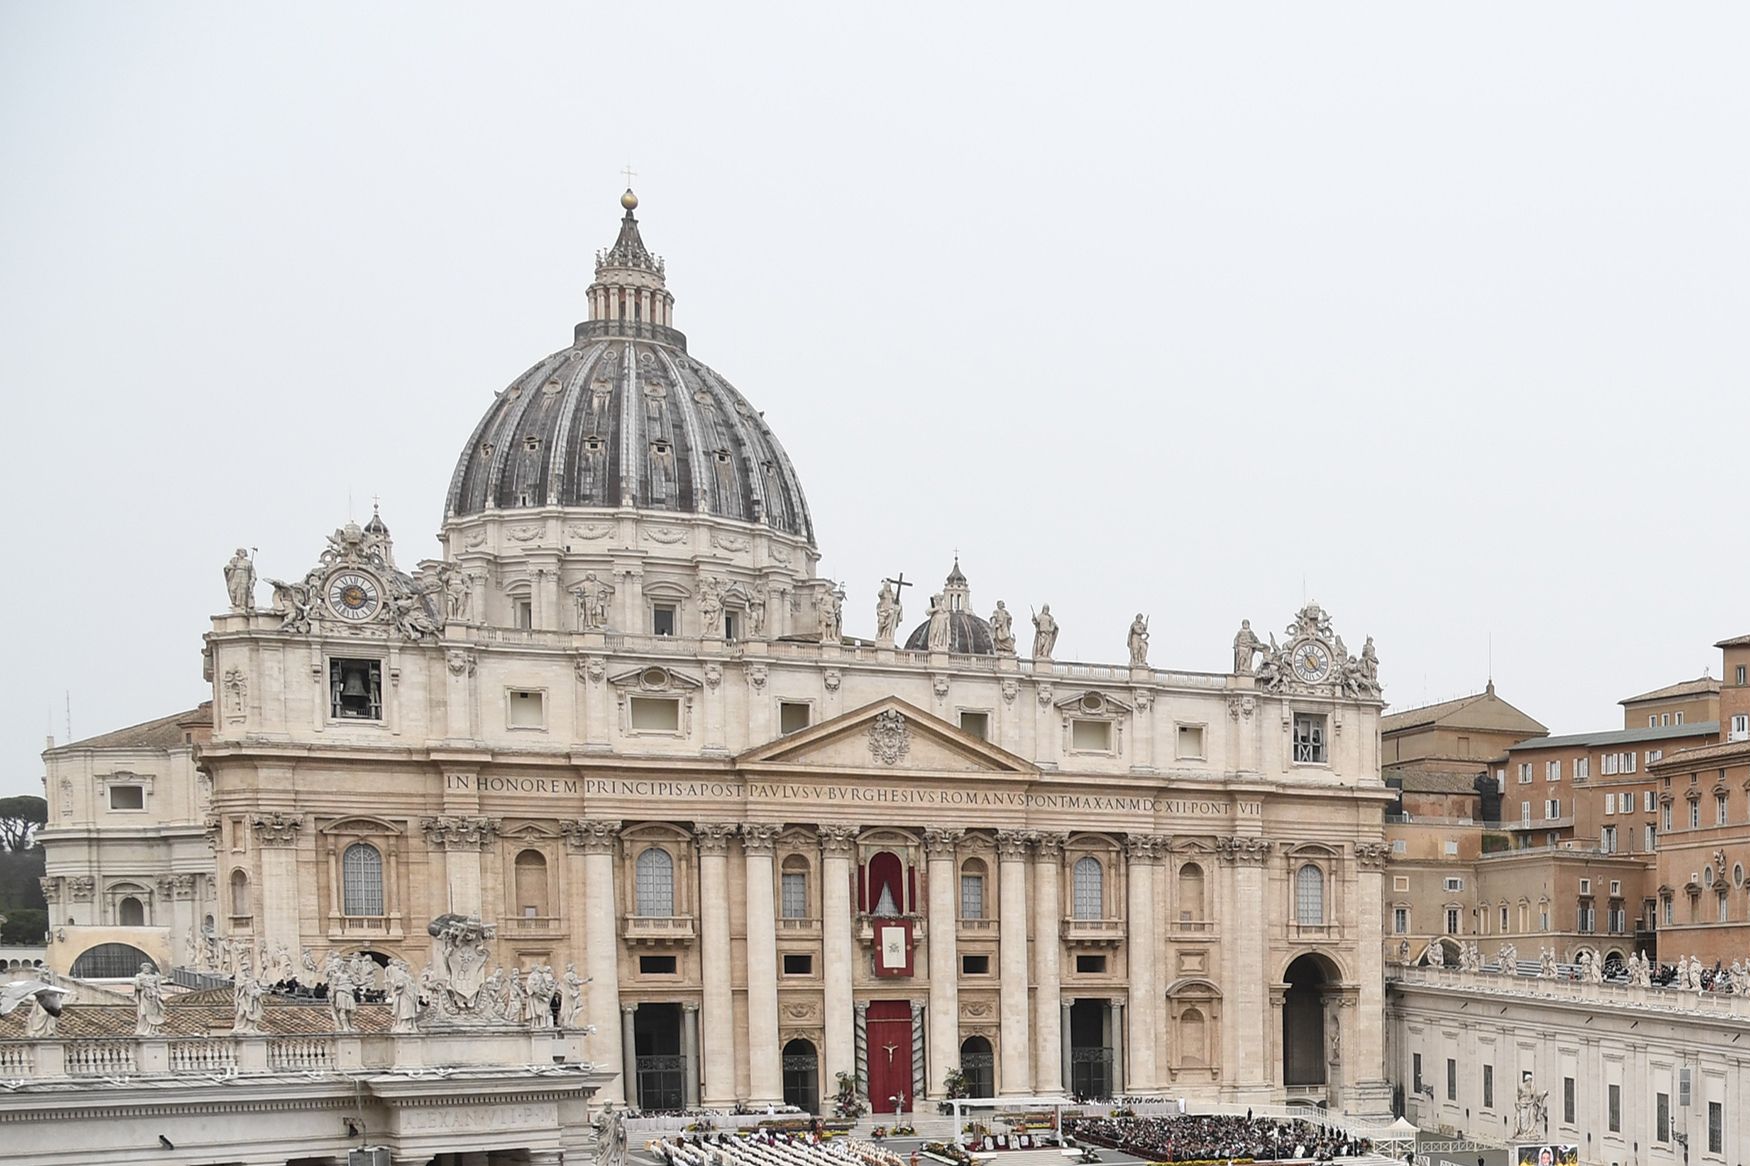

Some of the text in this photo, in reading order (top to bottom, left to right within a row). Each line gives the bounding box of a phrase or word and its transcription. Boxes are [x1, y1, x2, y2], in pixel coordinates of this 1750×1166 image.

[447, 775, 470, 789] IN
[477, 777, 577, 793] HONOREM
[1191, 802, 1231, 815] PONT
[1239, 802, 1261, 815] VII
